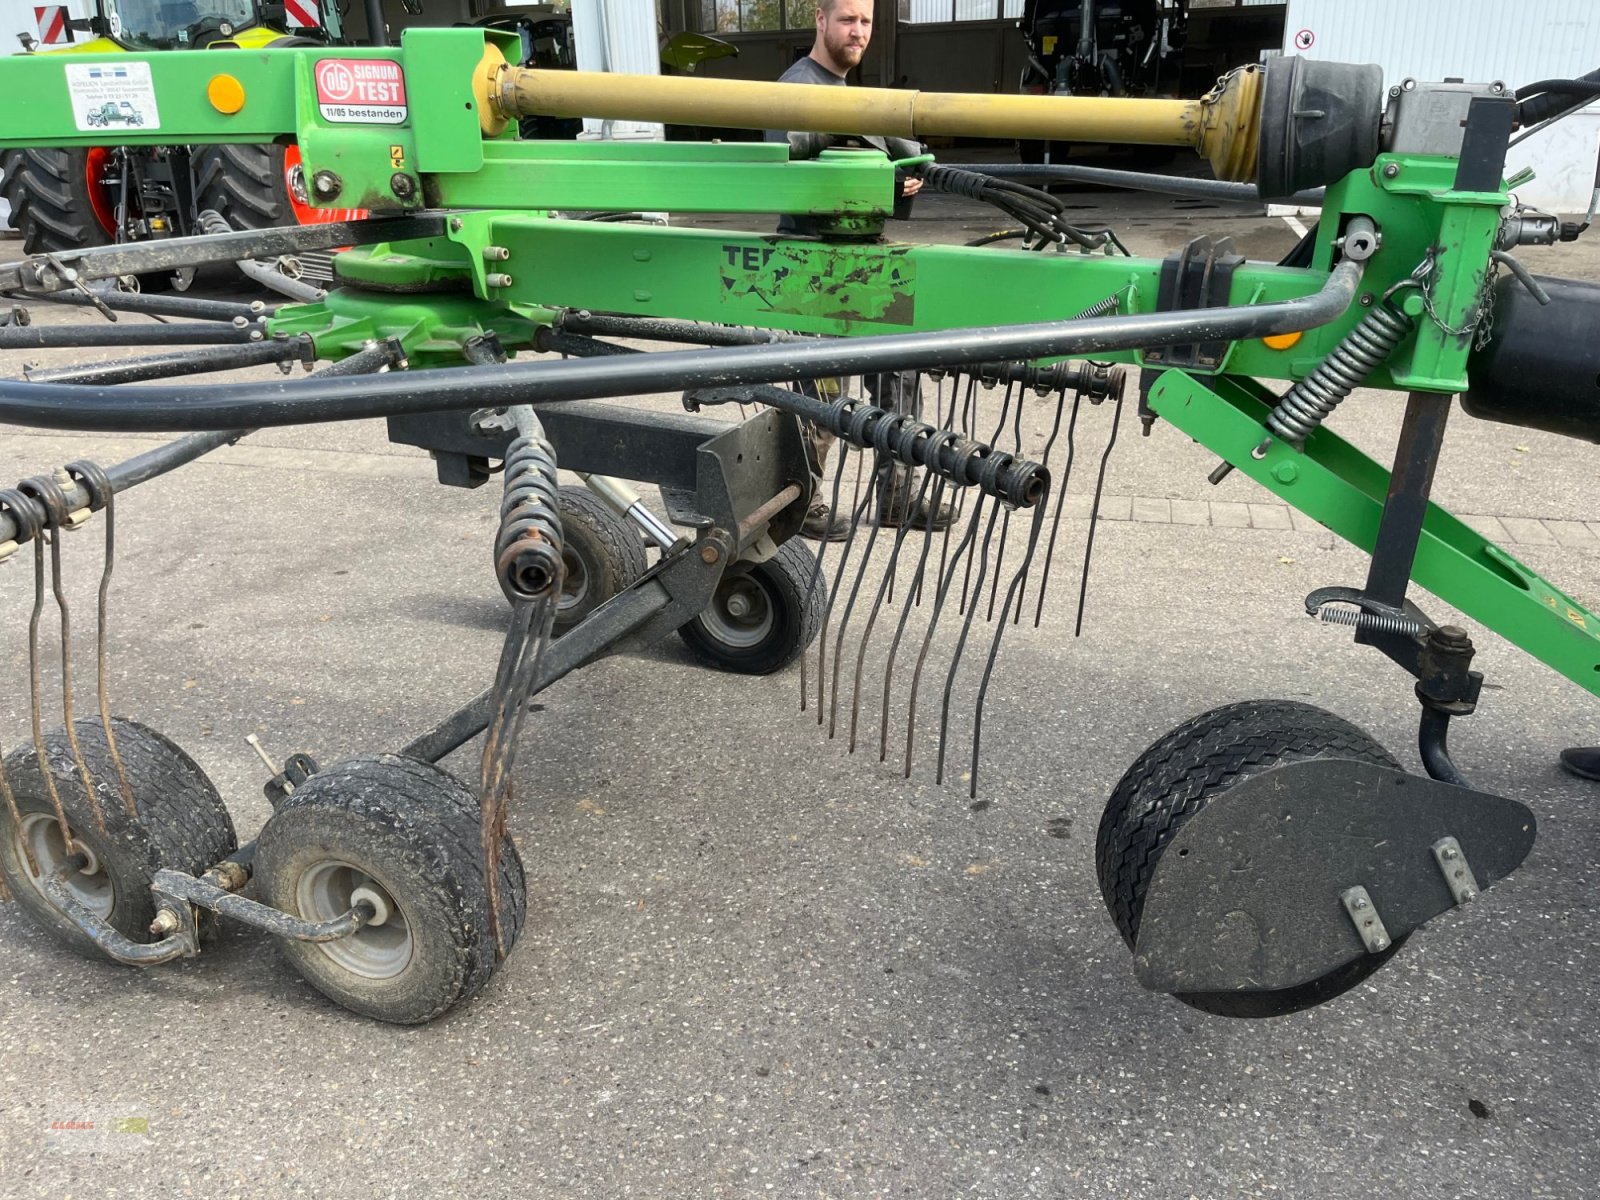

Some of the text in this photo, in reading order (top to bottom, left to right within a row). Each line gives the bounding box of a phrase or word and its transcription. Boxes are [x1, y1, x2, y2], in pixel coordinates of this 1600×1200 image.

[326, 64, 349, 91] DLG
[353, 65, 398, 79] SIGNUM
[356, 82, 399, 101] TEST
[326, 107, 403, 118] 11/05 bestanden
